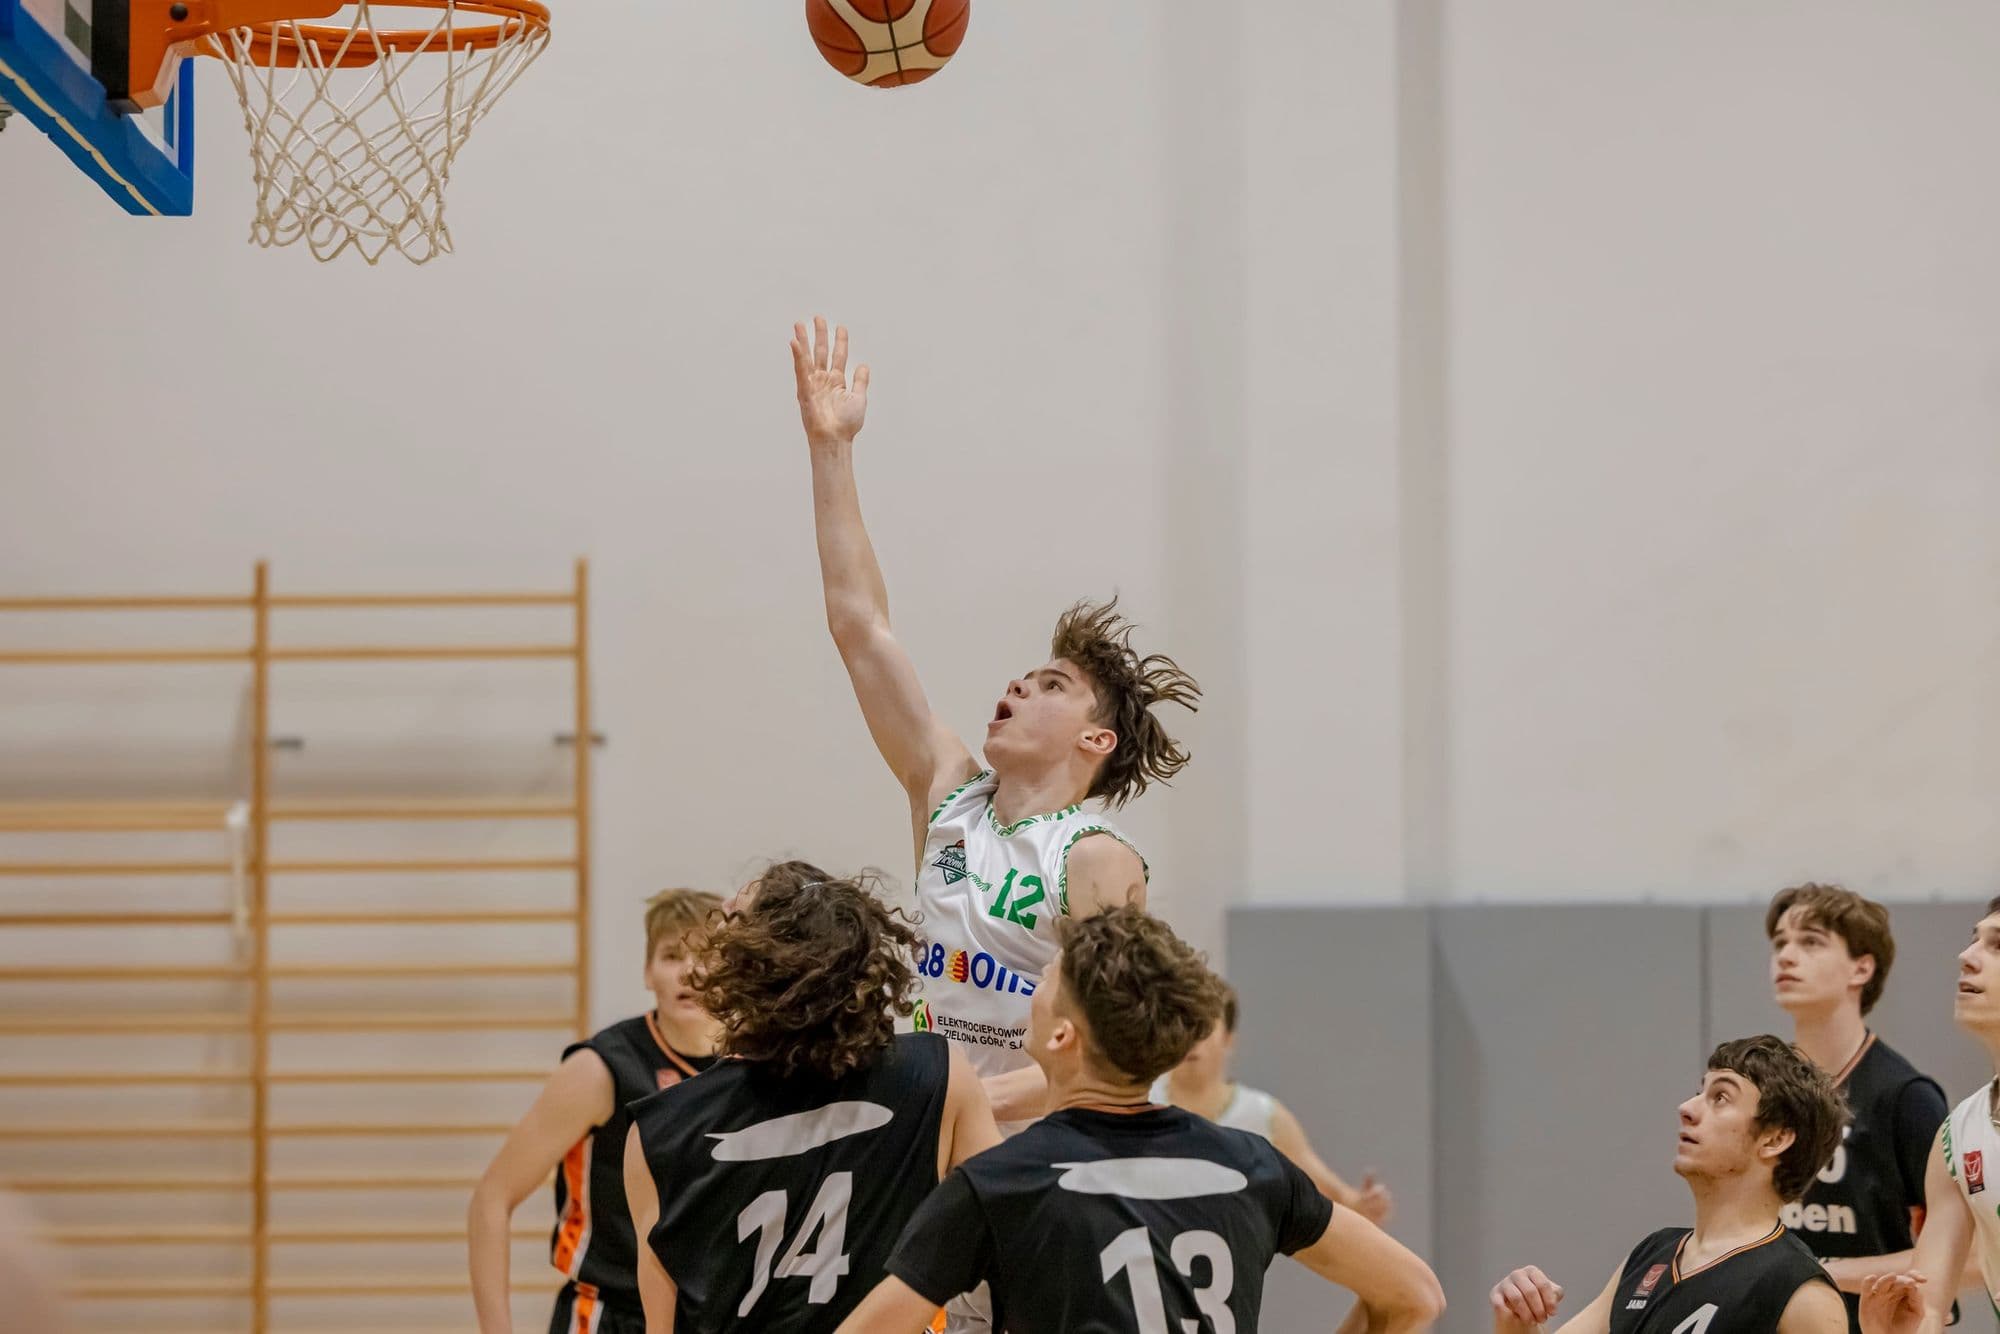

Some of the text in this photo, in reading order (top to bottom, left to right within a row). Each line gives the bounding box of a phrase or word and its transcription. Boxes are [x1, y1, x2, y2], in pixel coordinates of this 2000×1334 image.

[989, 868, 1045, 930] 12
[737, 1171, 853, 1318] 14
[1100, 1226, 1237, 1334] 13
